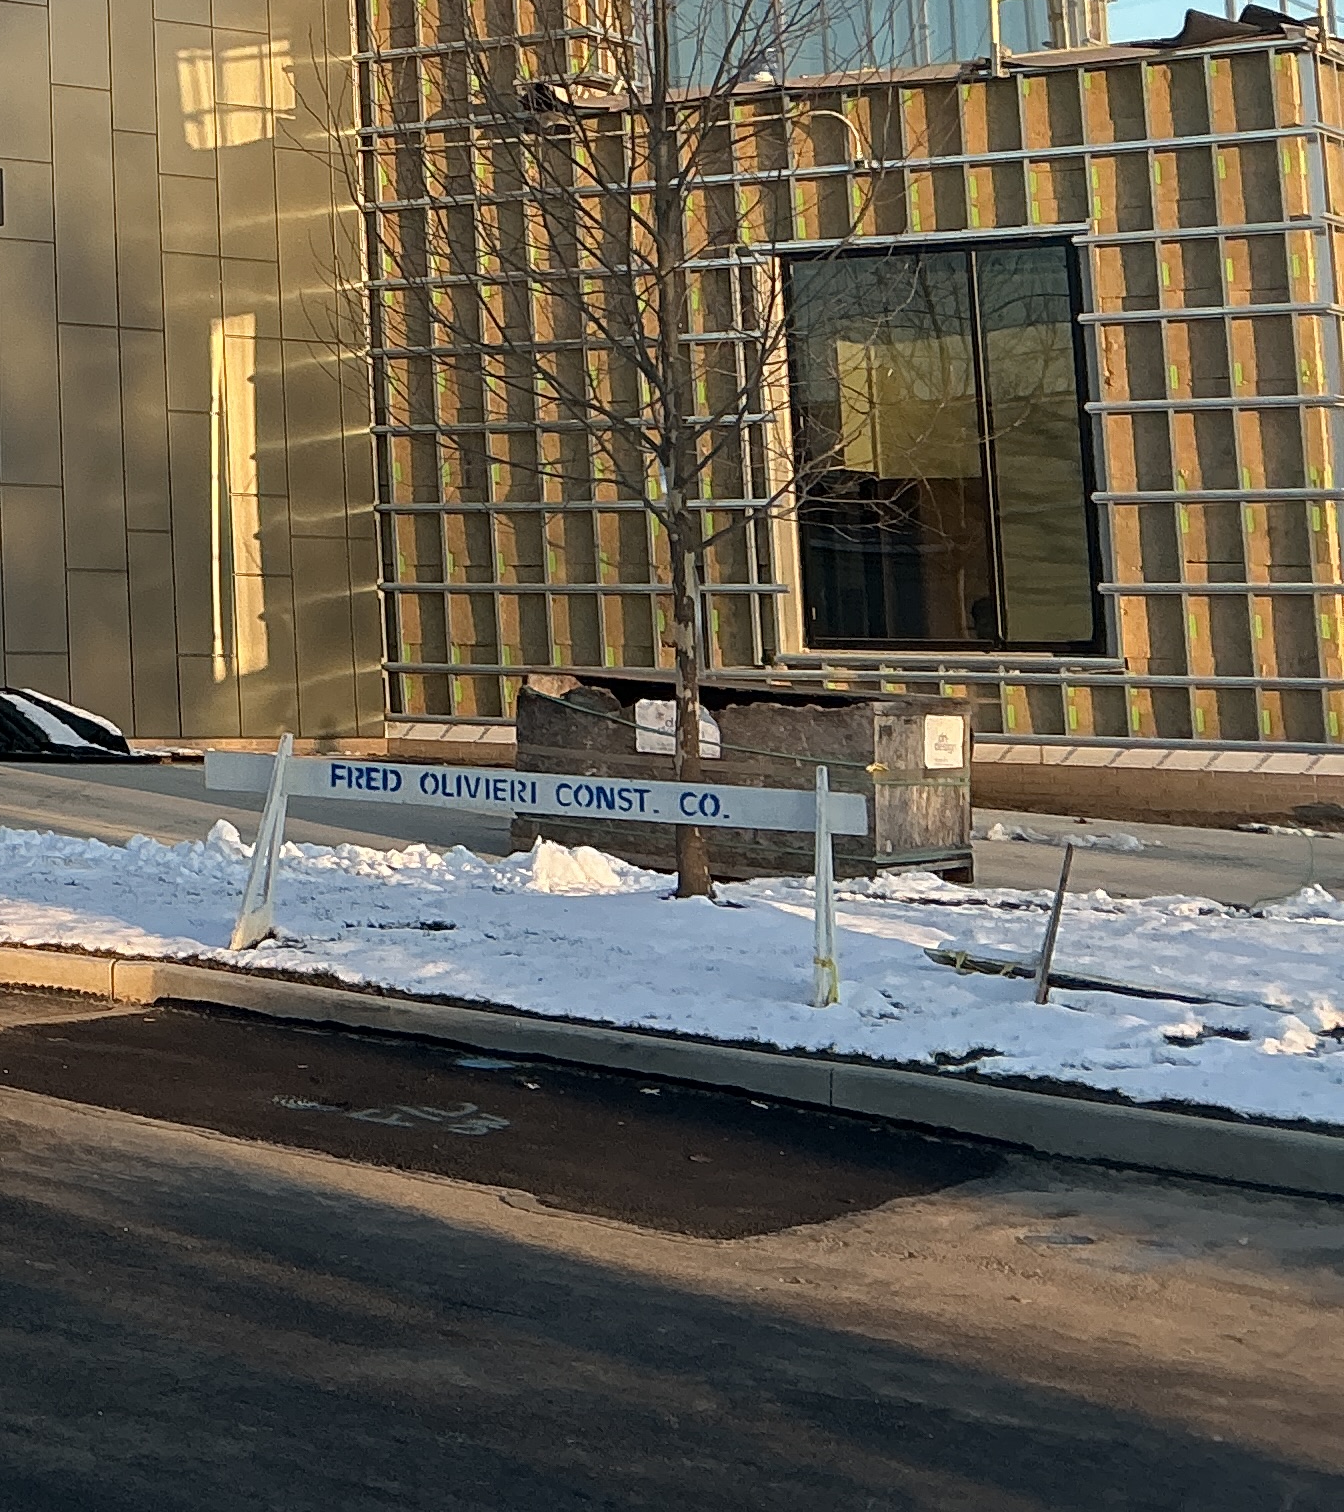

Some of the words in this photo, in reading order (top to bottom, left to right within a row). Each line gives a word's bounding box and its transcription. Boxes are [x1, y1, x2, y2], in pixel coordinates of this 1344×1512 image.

[330, 763, 403, 792] FRED
[419, 771, 538, 805] OLIVIERI
[555, 782, 660, 814] CONST.
[680, 791, 731, 819] CO.
